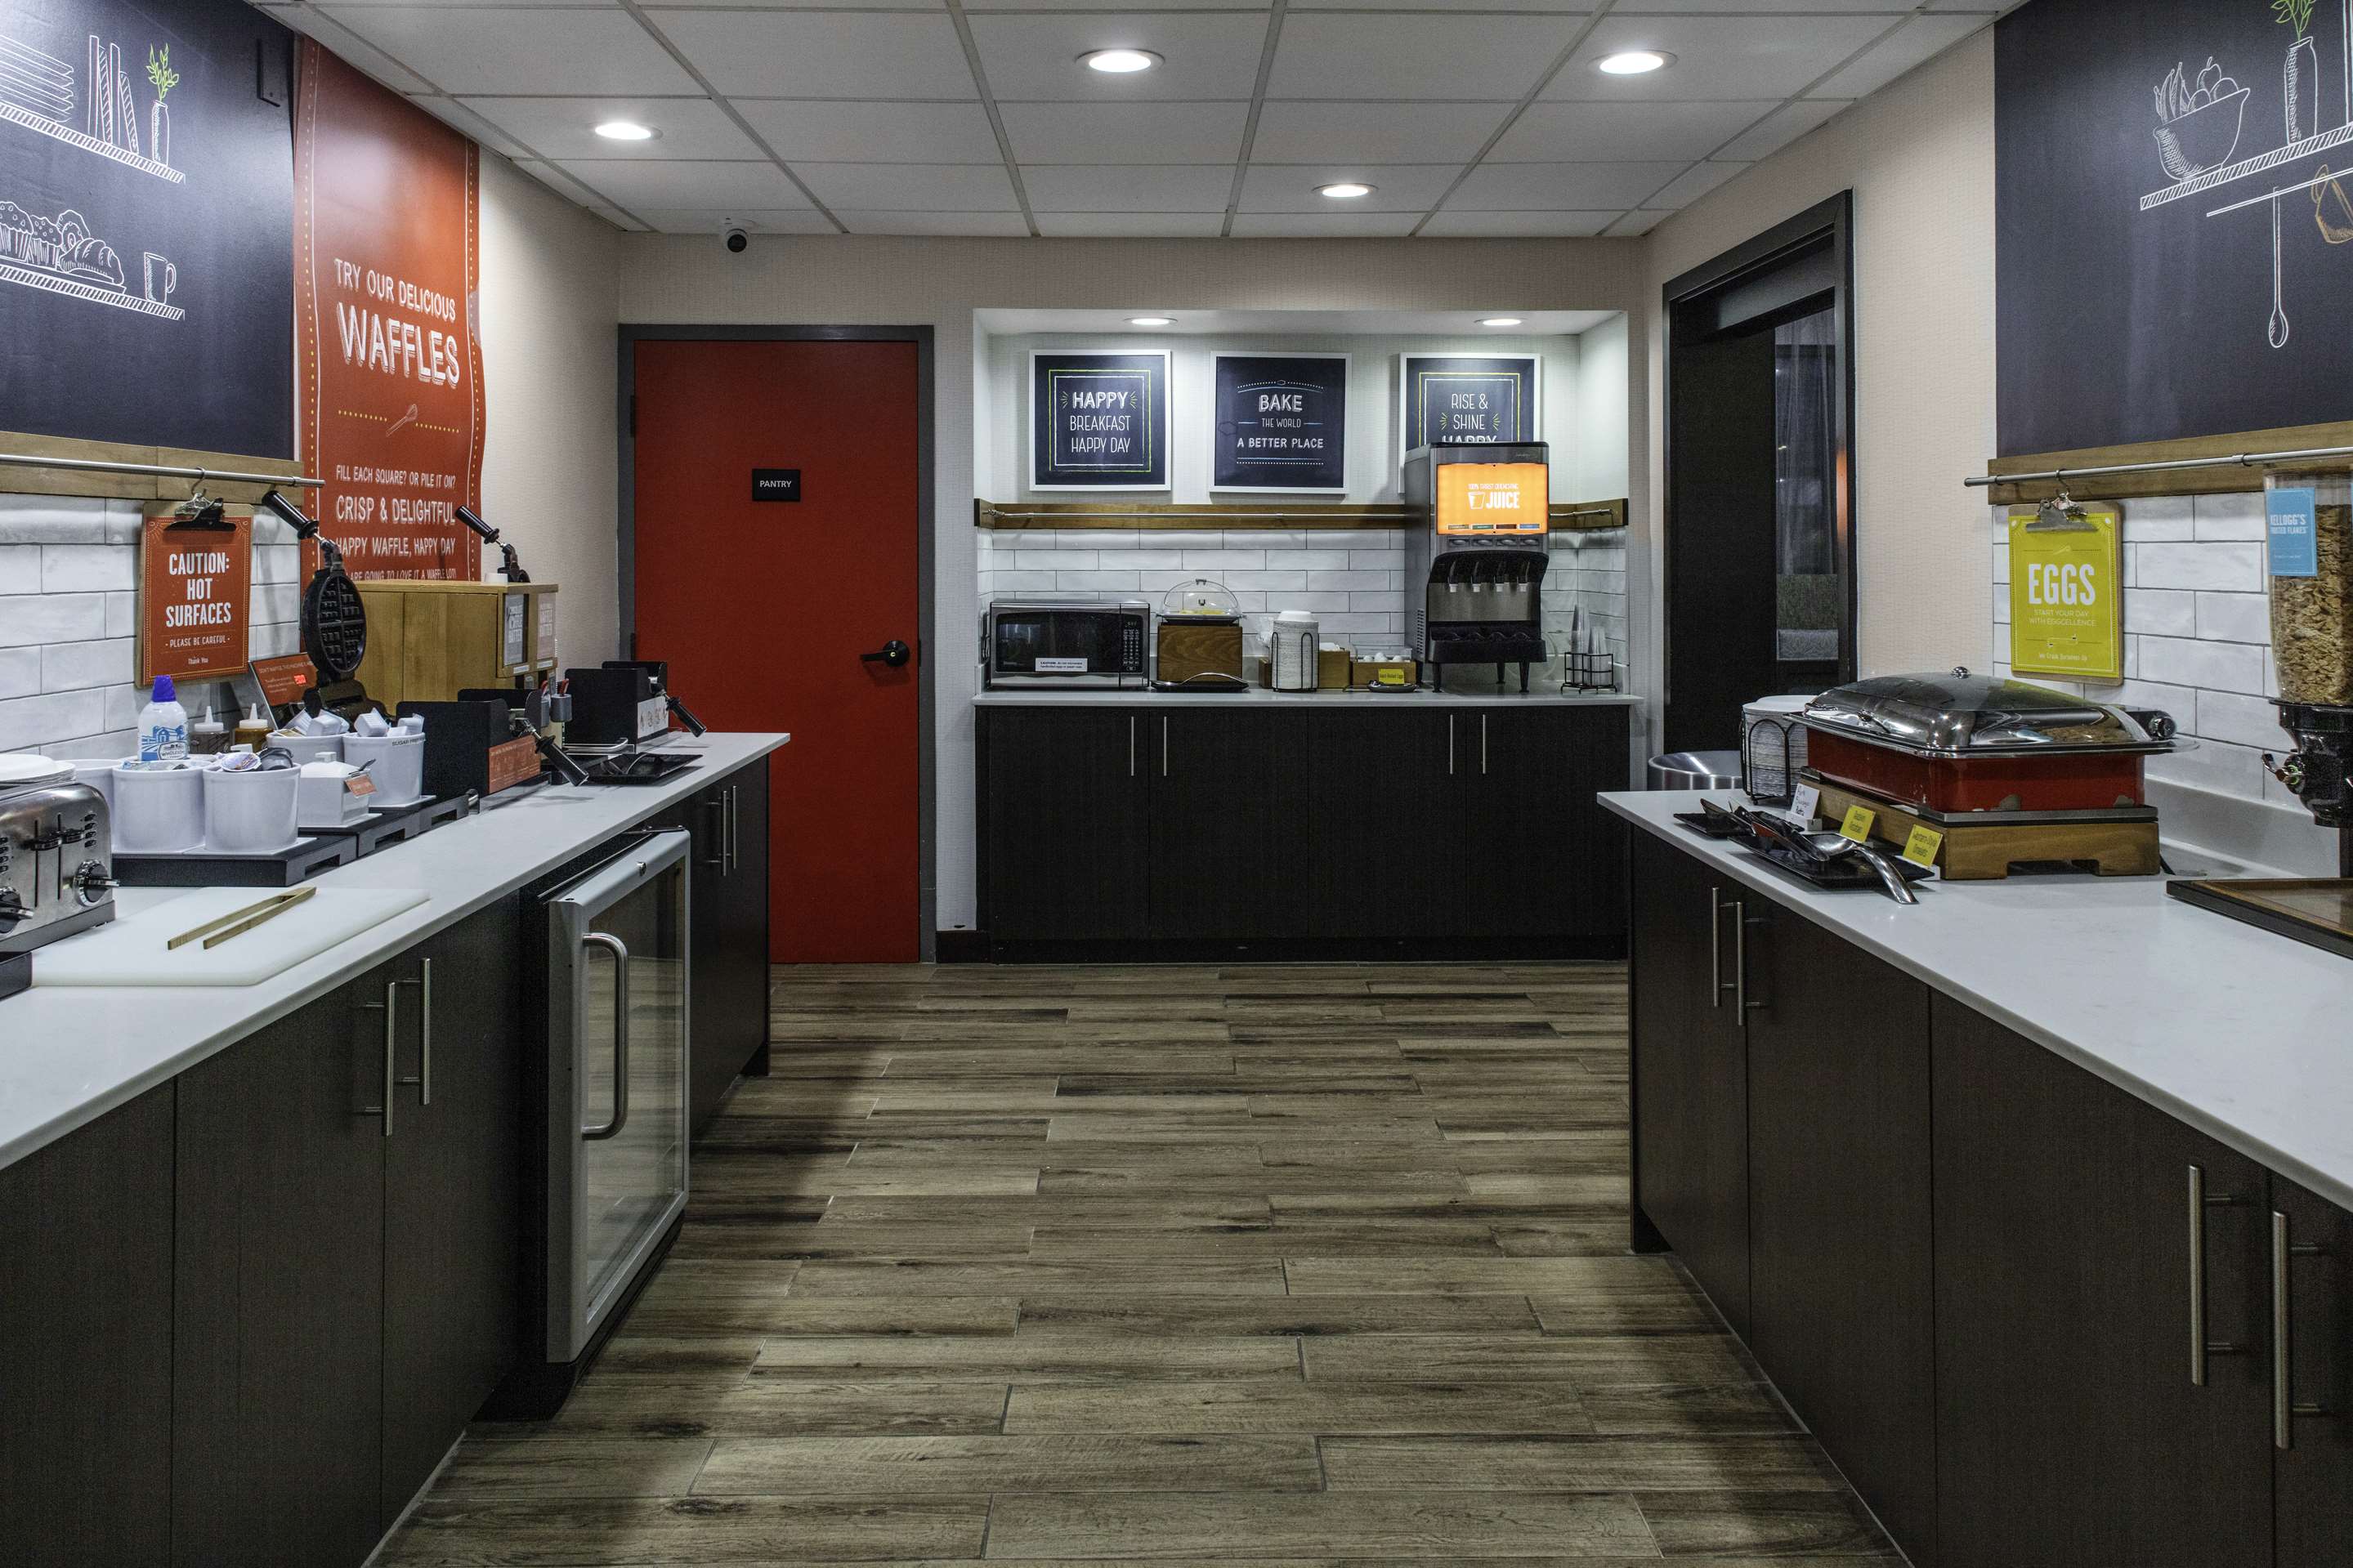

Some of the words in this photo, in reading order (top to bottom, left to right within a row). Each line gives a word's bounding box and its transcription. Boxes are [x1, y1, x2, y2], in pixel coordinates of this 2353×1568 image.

[333, 258, 361, 292] TRY
[367, 270, 395, 303] OUR
[398, 279, 456, 323] DELICIOUS
[336, 302, 459, 390] WAFFLES
[1072, 391, 1129, 409] HAPPY
[1259, 394, 1303, 412] BAKE
[1452, 393, 1475, 409] RISE
[1478, 393, 1488, 409] &
[1070, 415, 1131, 431] BREAKFAST
[1262, 418, 1274, 428] THE
[1277, 418, 1301, 428] WORLD
[1453, 414, 1485, 430] SHINE
[1071, 437, 1107, 453] HAPPY
[1111, 437, 1130, 453] DAY
[1237, 437, 1244, 449] A
[1248, 437, 1287, 449] BETTER
[1291, 438, 1324, 449] PLACE
[336, 464, 351, 480] FILL
[353, 466, 374, 482] EACH
[375, 468, 407, 485] SQUARE?
[409, 471, 419, 485] OR
[421, 472, 435, 488] PILE
[436, 475, 442, 488] IT
[444, 475, 456, 489] ON?
[759, 480, 792, 488] PANTRY
[1486, 491, 1520, 509] JUICE
[335, 494, 374, 524] CRISP
[380, 497, 388, 524] &
[391, 498, 456, 525] DELIGHTFUL
[372, 536, 412, 558] WAFFLE,
[414, 537, 438, 556] HAPPY
[441, 537, 456, 556] DAY
[169, 552, 230, 575] CAUTION:
[186, 578, 212, 601] HOT
[2028, 563, 2096, 605] EGGS
[165, 601, 231, 628] SURFACES
[2046, 619, 2097, 627] EGGCELLENCE
[170, 637, 191, 648] PLEASE
[193, 637, 200, 646] BE
[202, 635, 226, 645] CAREFUL
